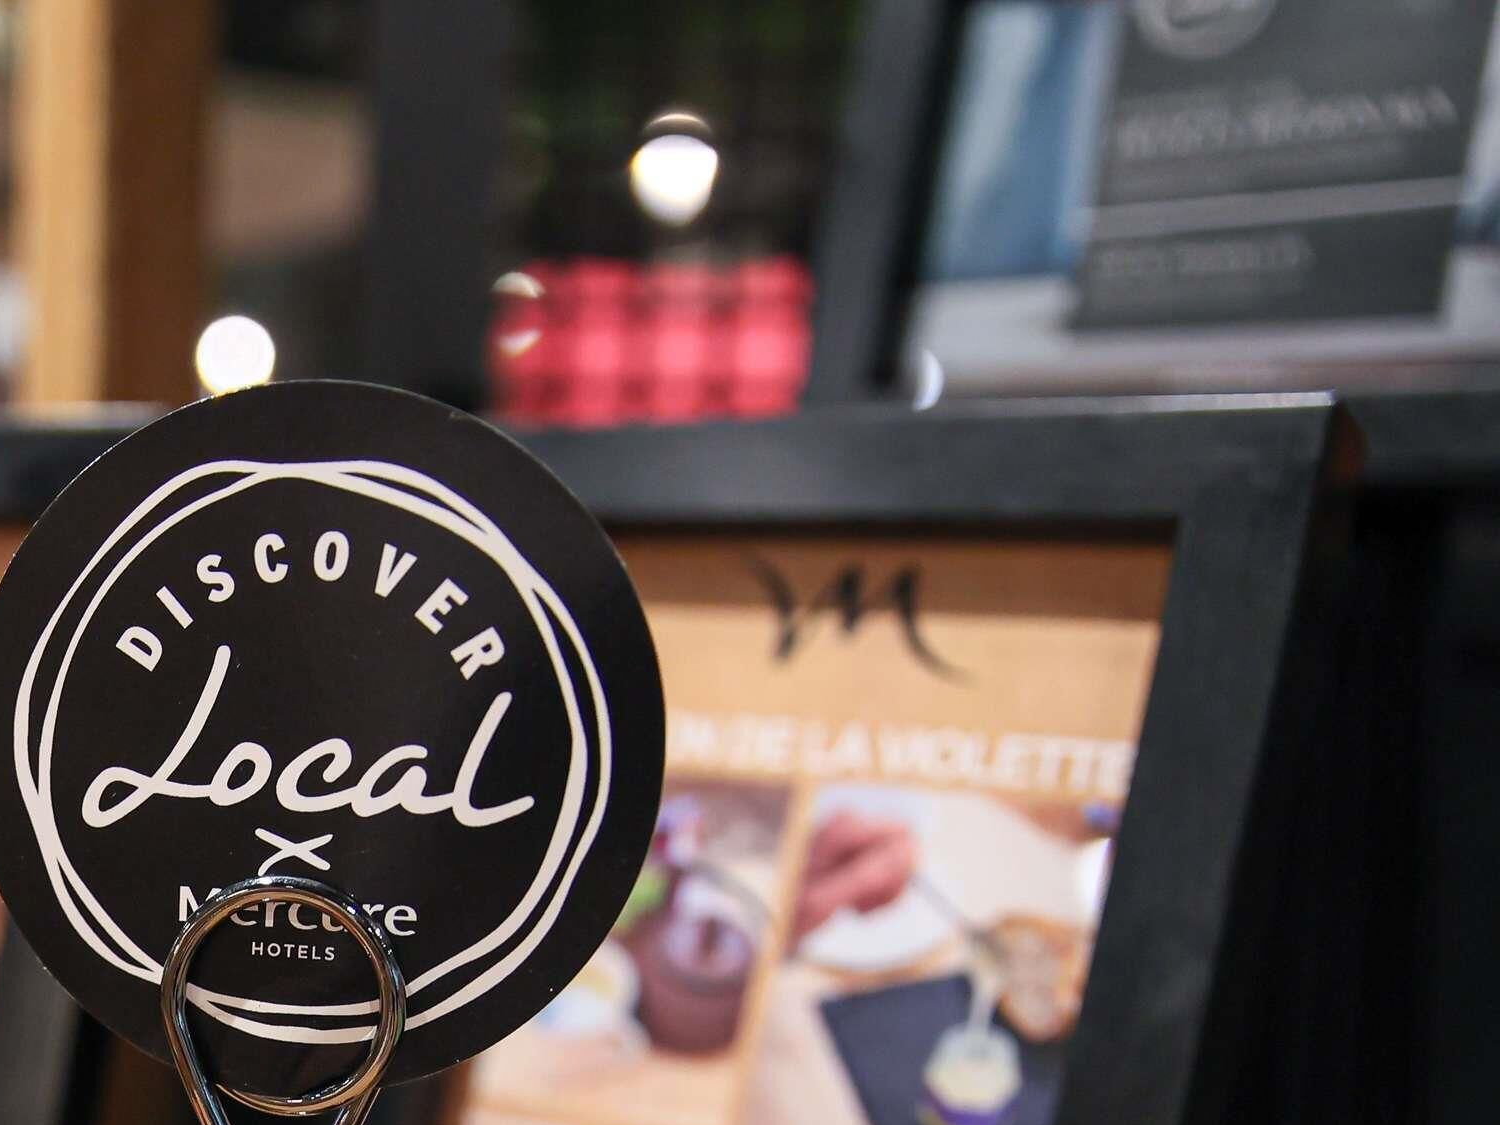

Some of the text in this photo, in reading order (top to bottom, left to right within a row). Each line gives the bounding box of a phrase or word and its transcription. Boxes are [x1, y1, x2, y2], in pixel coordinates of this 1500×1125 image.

[115, 530, 505, 681] DISCOVER
[81, 644, 535, 829] Local
[800, 717, 873, 779] LA
[251, 941, 336, 961] HOTELS
